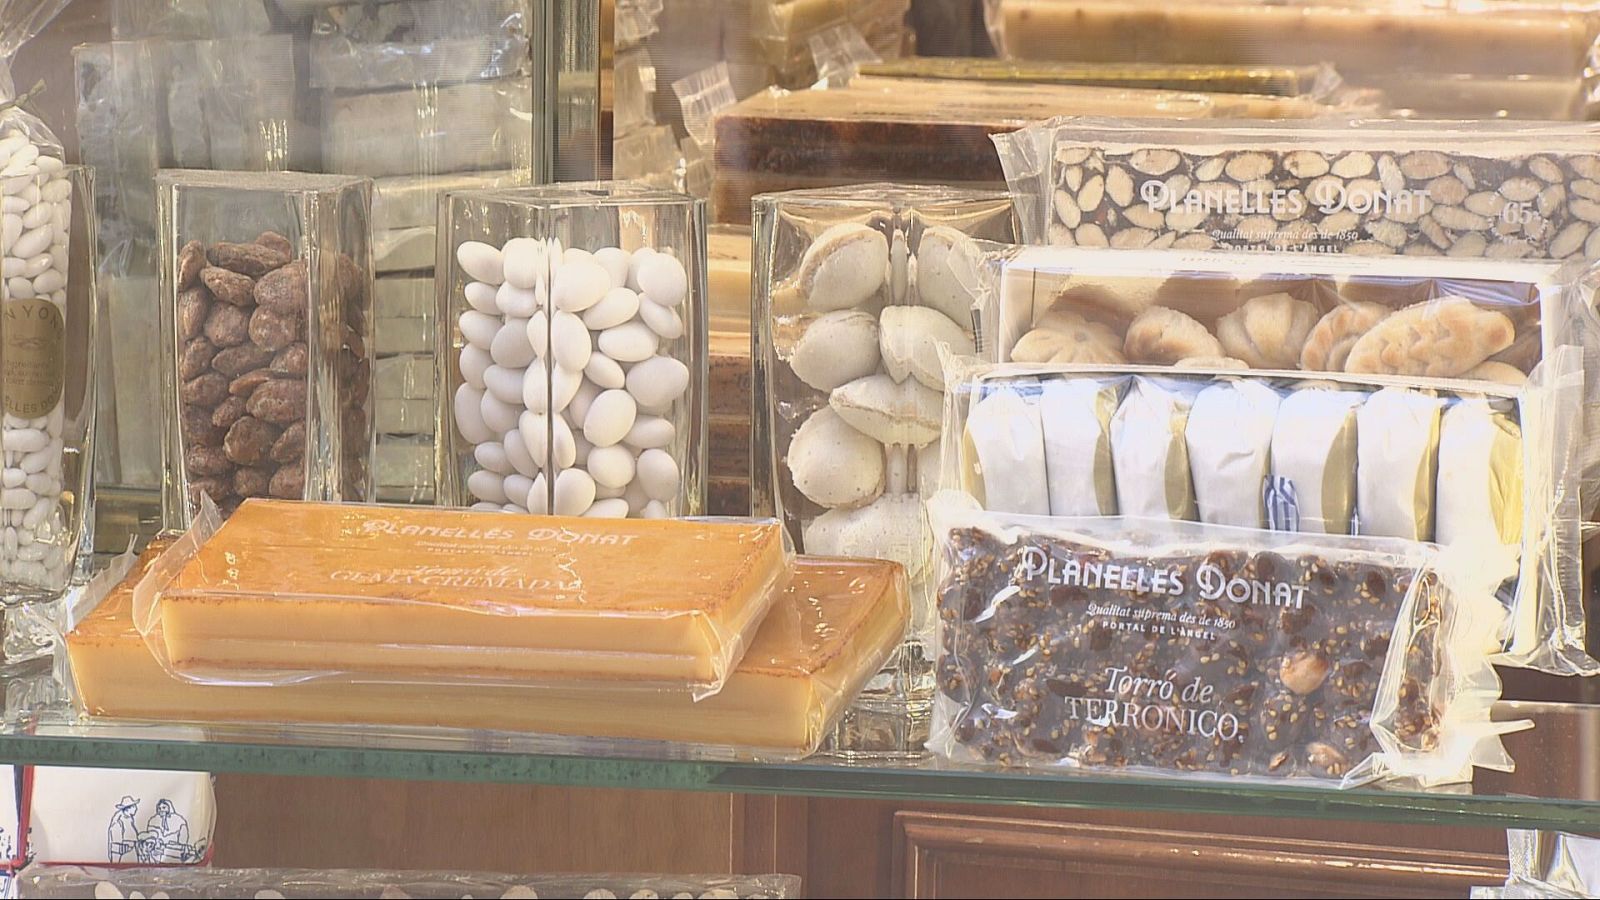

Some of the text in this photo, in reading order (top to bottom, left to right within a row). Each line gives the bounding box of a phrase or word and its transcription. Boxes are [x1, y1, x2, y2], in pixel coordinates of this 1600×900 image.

[1140, 180, 1431, 214] PLANELLES DONAT
[1211, 228, 1253, 242] Qualitat
[1256, 230, 1299, 242] suprema
[1336, 229, 1359, 241] 1850
[362, 519, 638, 545] PLANELLES DONAT
[1022, 547, 1310, 609] PLANELLES DONAT
[1086, 602, 1131, 618] Qualitat
[1132, 607, 1177, 622] suprema
[1198, 614, 1211, 626] de
[1214, 617, 1236, 630] 1850
[1102, 620, 1146, 633] PORTAL
[1151, 625, 1165, 634] DE
[1105, 666, 1214, 704] Torró de
